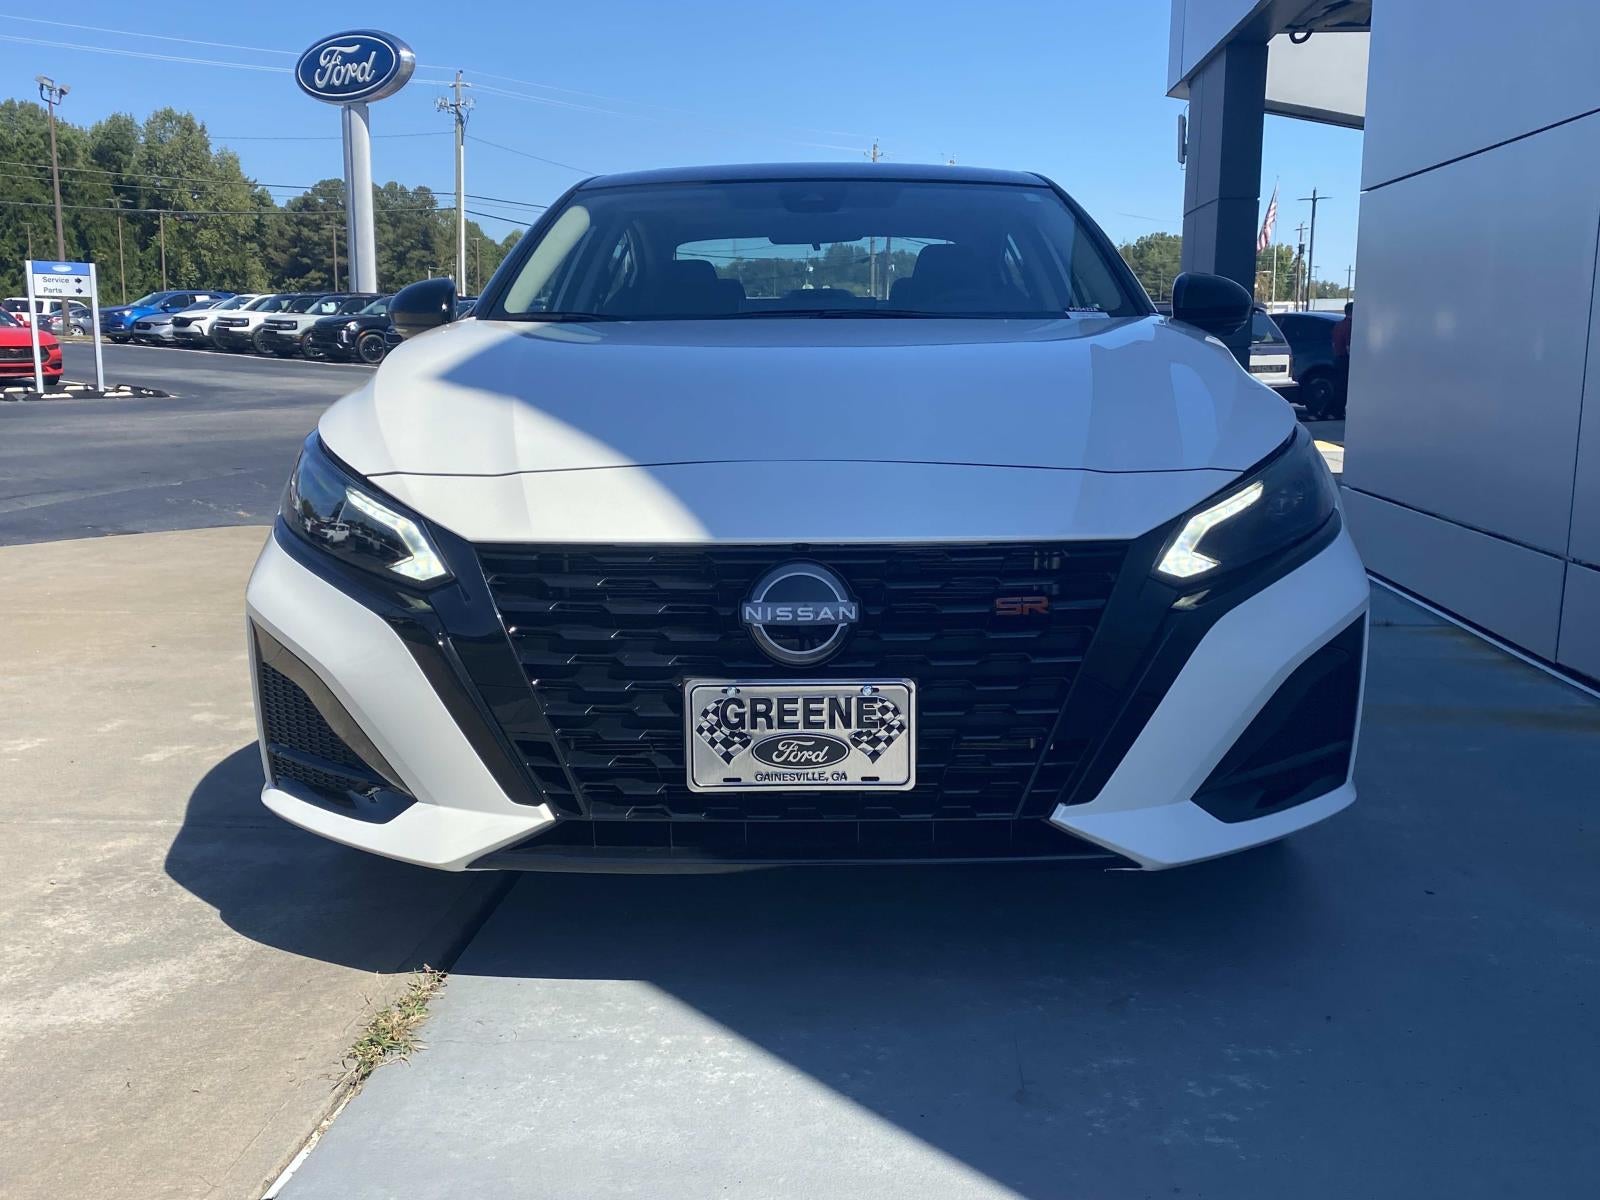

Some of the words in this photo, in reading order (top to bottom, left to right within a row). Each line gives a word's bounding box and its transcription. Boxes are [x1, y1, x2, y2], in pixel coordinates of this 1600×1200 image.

[314, 44, 376, 88] Ford
[745, 605, 857, 621] NISSAN
[995, 596, 1048, 615] SR
[719, 697, 880, 730] GREENE
[772, 740, 828, 763] Ford
[755, 772, 829, 783] GAINESVILLE,
[831, 772, 848, 782] GA
